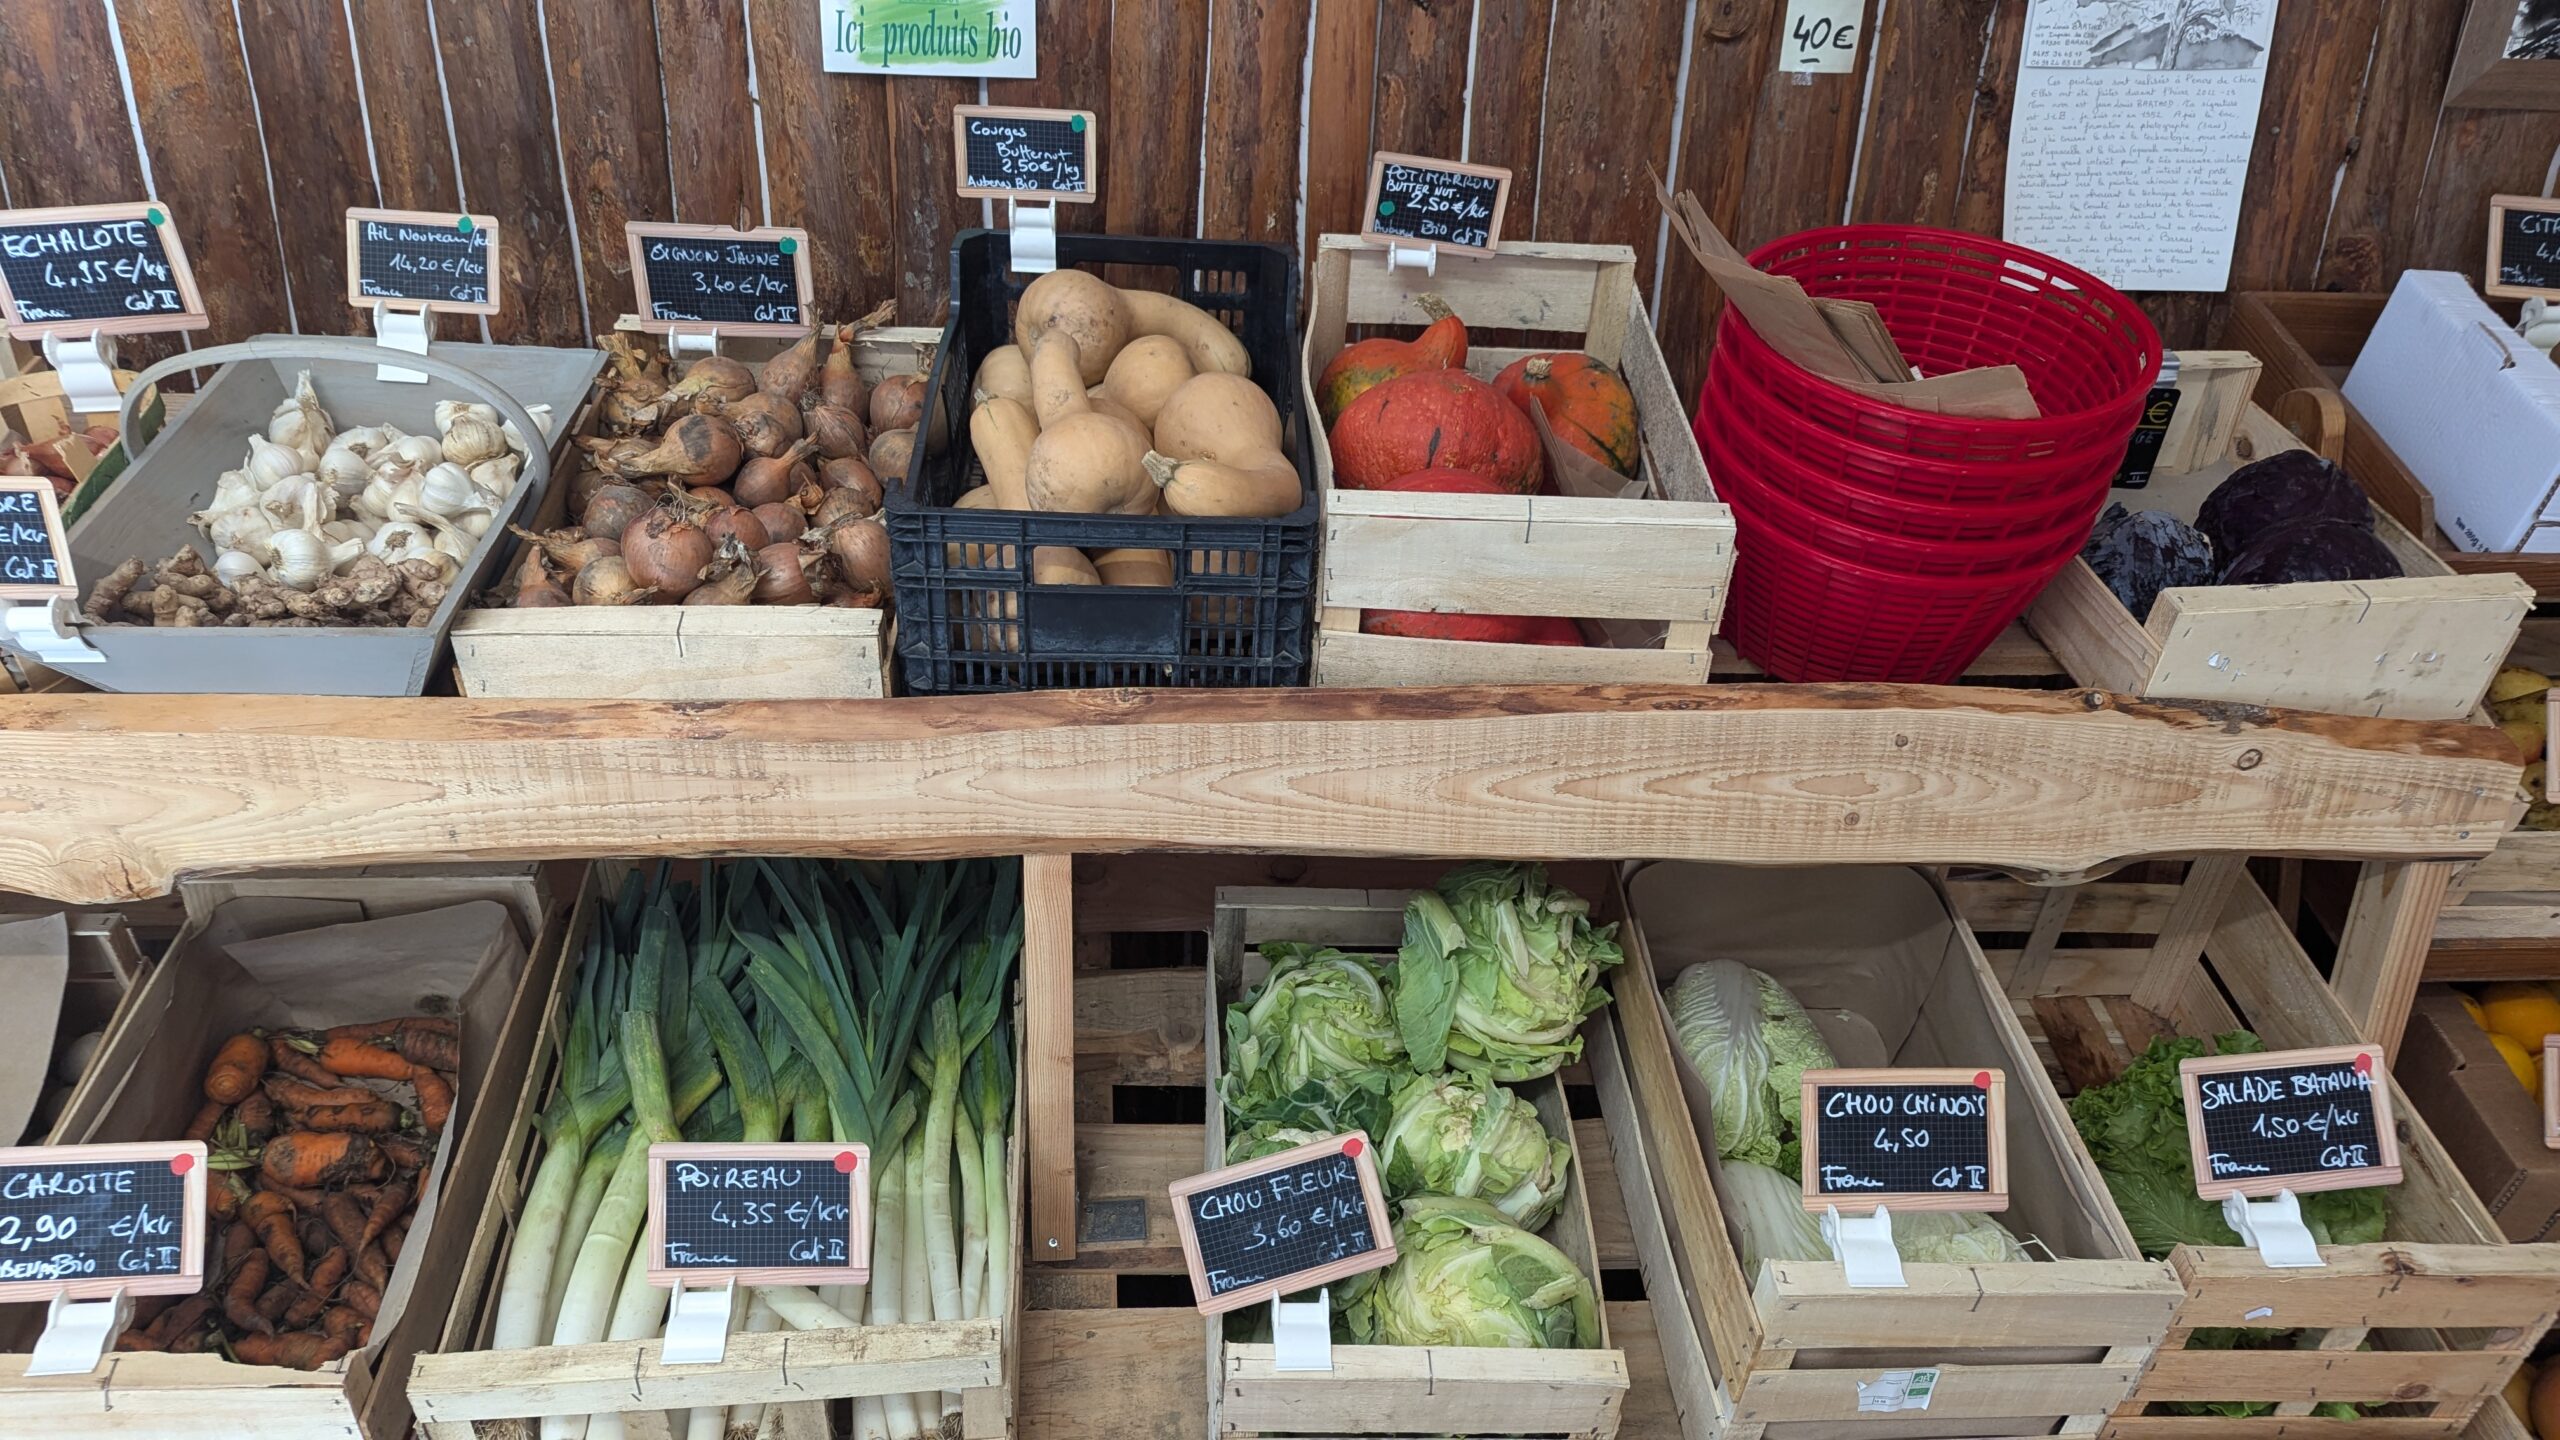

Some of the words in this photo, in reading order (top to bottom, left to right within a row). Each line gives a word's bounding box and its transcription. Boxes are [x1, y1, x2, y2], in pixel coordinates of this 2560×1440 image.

[834, 5, 866, 54] Ici
[881, 8, 978, 68] produits
[986, 10, 1022, 59] bio
[1793, 14, 1854, 52] 40€
[970, 121, 1028, 145] Courges
[995, 142, 1073, 161] Butternut
[1386, 179, 1430, 195] BUTTER
[1, 220, 149, 258] ECHALOTE
[726, 244, 781, 267] JAUNE
[124, 289, 155, 311] Cat
[753, 302, 776, 322] Cat
[5, 555, 39, 579] Cat
[1825, 1091, 1895, 1119] CHOU
[2201, 1075, 2286, 1110] SALADE
[1873, 1127, 1930, 1154] 4,50
[2318, 1144, 2352, 1168] Cat
[3, 1169, 136, 1200] CAROTTE
[1199, 1189, 1263, 1221] CHOU
[1268, 1160, 1357, 1202] FLEUR
[1931, 1165, 1963, 1189] Cat
[711, 1200, 777, 1229] 4,35
[0, 1214, 78, 1253] 2,90
[788, 1236, 826, 1263] Cat
